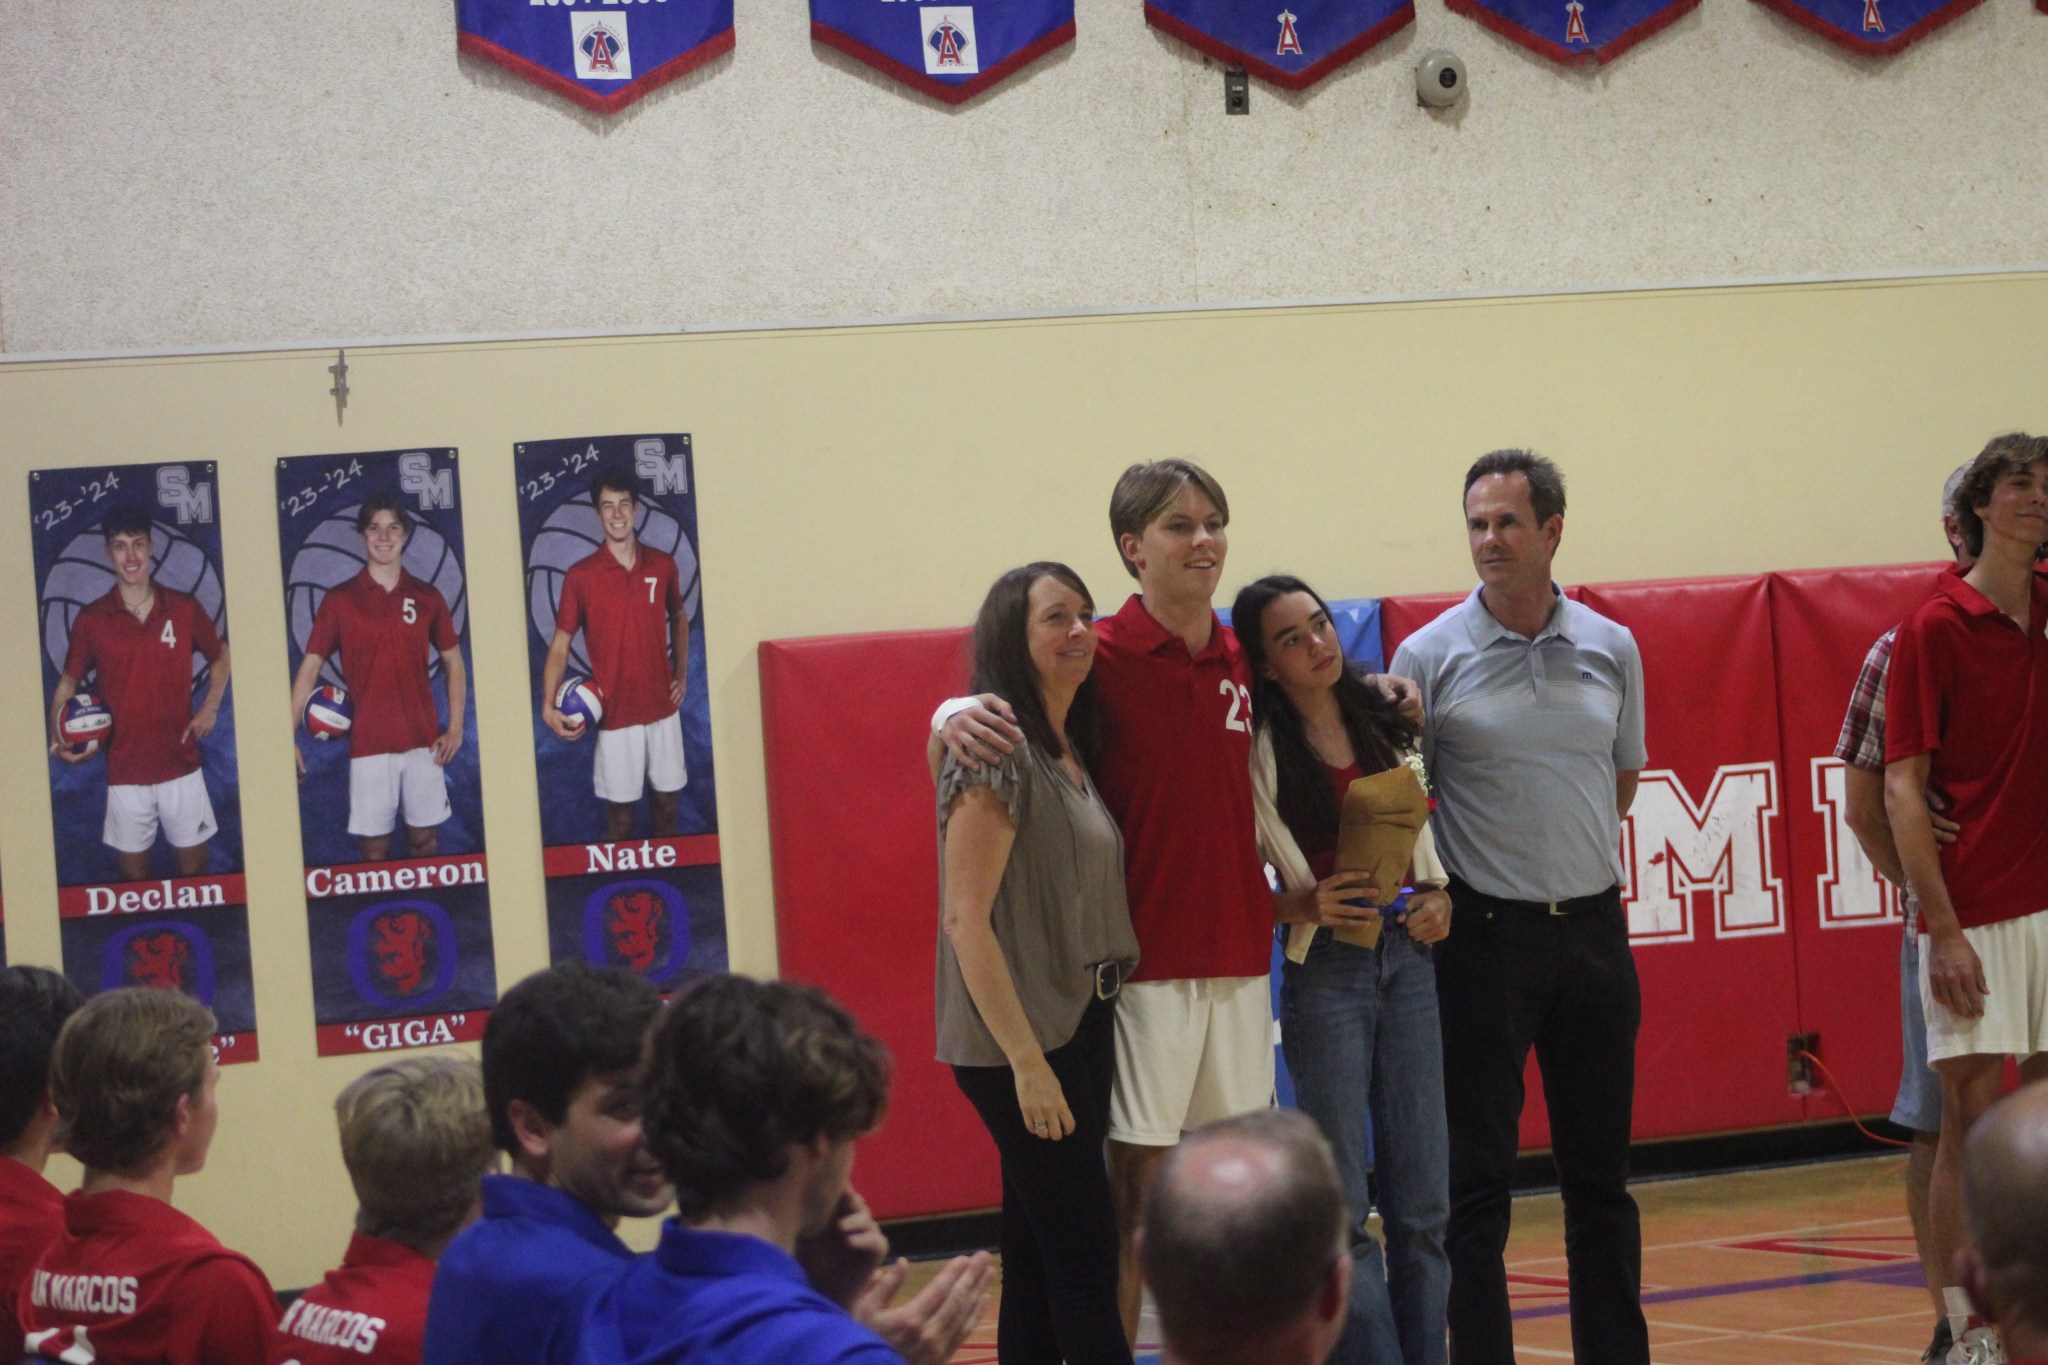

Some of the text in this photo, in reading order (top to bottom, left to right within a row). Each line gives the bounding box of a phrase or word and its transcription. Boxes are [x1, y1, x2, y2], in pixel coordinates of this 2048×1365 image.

[399, 452, 455, 511] SM
[634, 437, 689, 496] SM
[156, 465, 213, 525] SM
[644, 576, 658, 604] 7
[402, 597, 417, 625] 5
[161, 619, 177, 649] 4
[585, 839, 678, 874] Nate
[86, 879, 226, 916] Declan
[306, 859, 486, 899] Cameron
[50, 1273, 139, 1315] MARCOS
[293, 1302, 387, 1355] MARCOS
